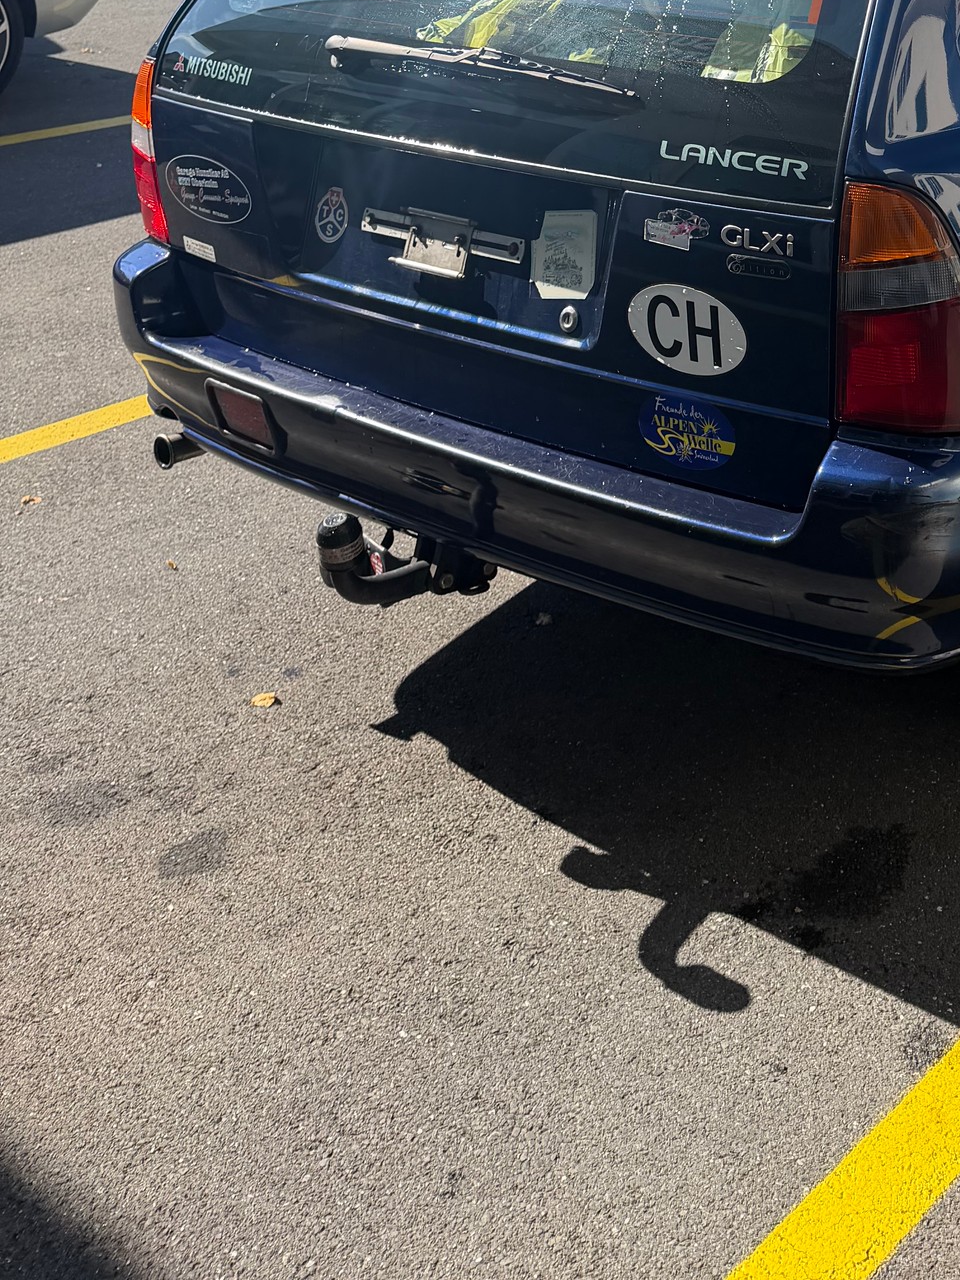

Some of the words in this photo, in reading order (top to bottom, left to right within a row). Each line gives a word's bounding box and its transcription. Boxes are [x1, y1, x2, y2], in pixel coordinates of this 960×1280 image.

[186, 56, 252, 86] MITSUBISHI
[659, 140, 809, 181] LANCER
[720, 224, 795, 257] GLXi
[646, 294, 723, 369] CH
[655, 395, 688, 418] Freunde
[690, 405, 705, 420] der
[651, 414, 698, 434] ALPEN
[685, 433, 722, 453] Welle
